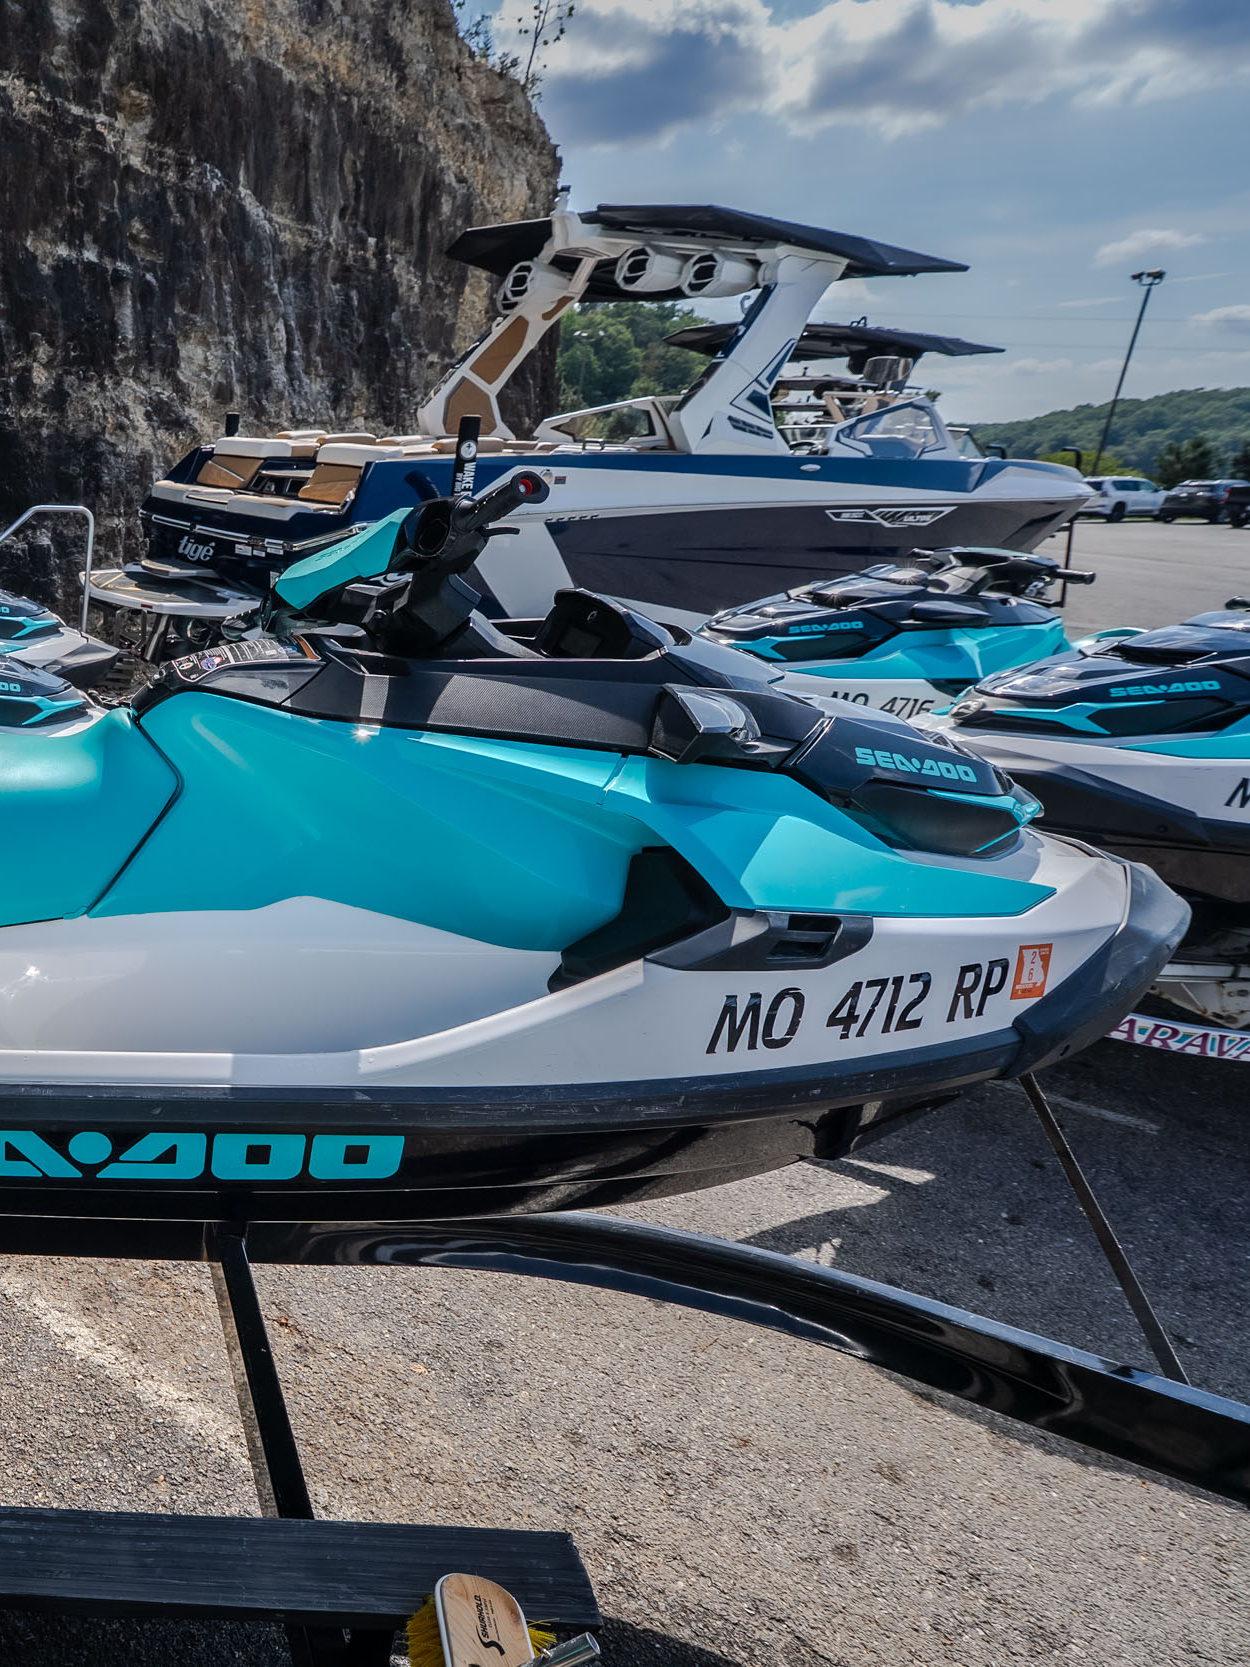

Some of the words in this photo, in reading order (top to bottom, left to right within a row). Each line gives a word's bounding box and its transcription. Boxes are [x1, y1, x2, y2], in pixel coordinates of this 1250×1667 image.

[461, 462, 476, 489] WAKE
[178, 536, 216, 561] tigé
[705, 987, 805, 1054] MO
[826, 971, 932, 1040] 4712
[946, 958, 1009, 1023] RP
[474, 1594, 490, 1639] SHURHOLD
